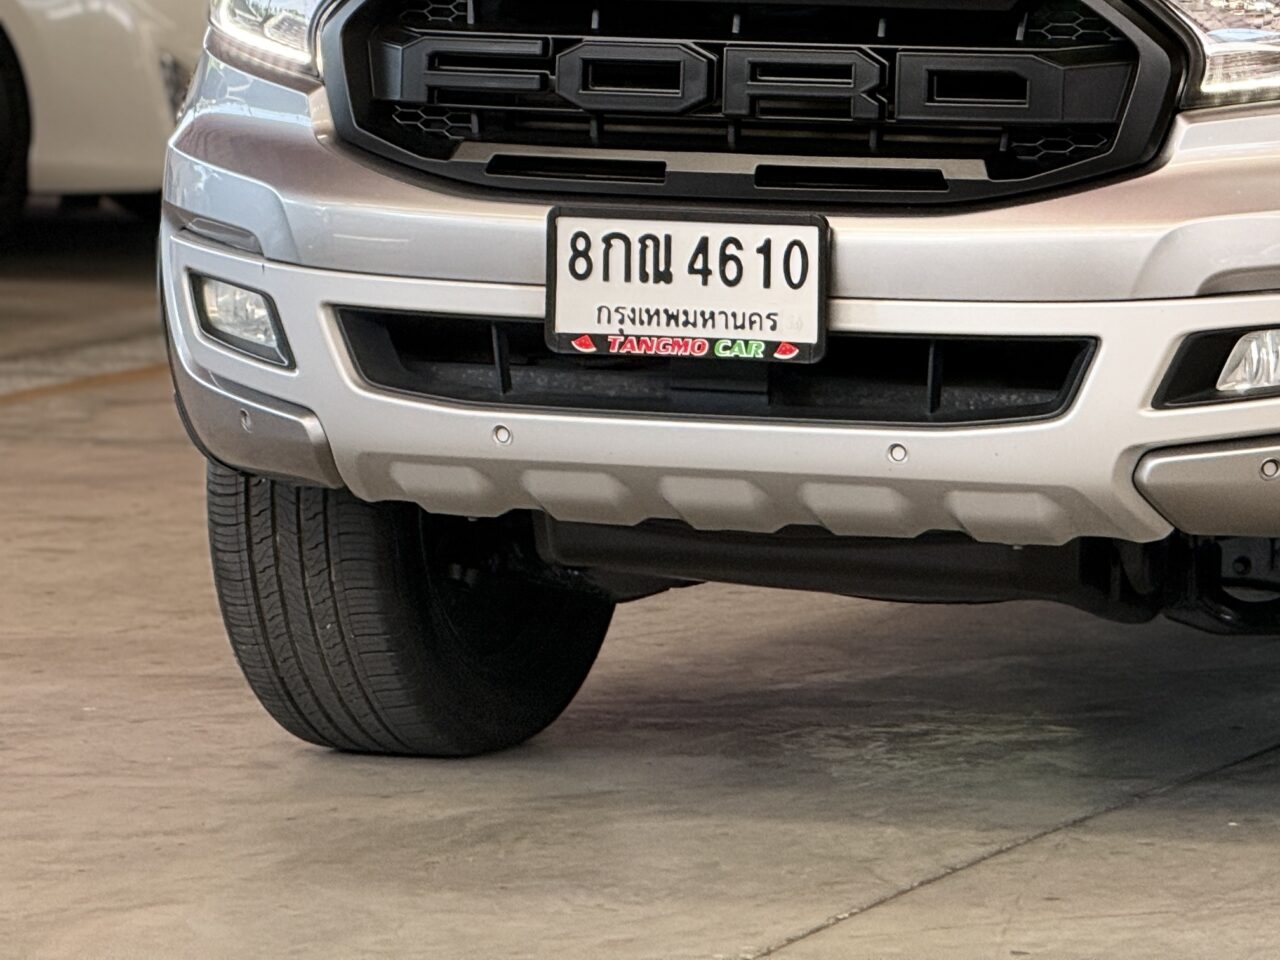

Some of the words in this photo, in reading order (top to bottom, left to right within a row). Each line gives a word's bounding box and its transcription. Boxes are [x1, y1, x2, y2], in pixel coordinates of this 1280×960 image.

[398, 35, 1064, 123] FORD
[568, 230, 674, 285] 8กณ
[687, 235, 810, 290] 4610
[596, 304, 779, 335] กรุงเทพมหานคร
[607, 335, 710, 357] TANGMO
[714, 339, 766, 359] CAR
